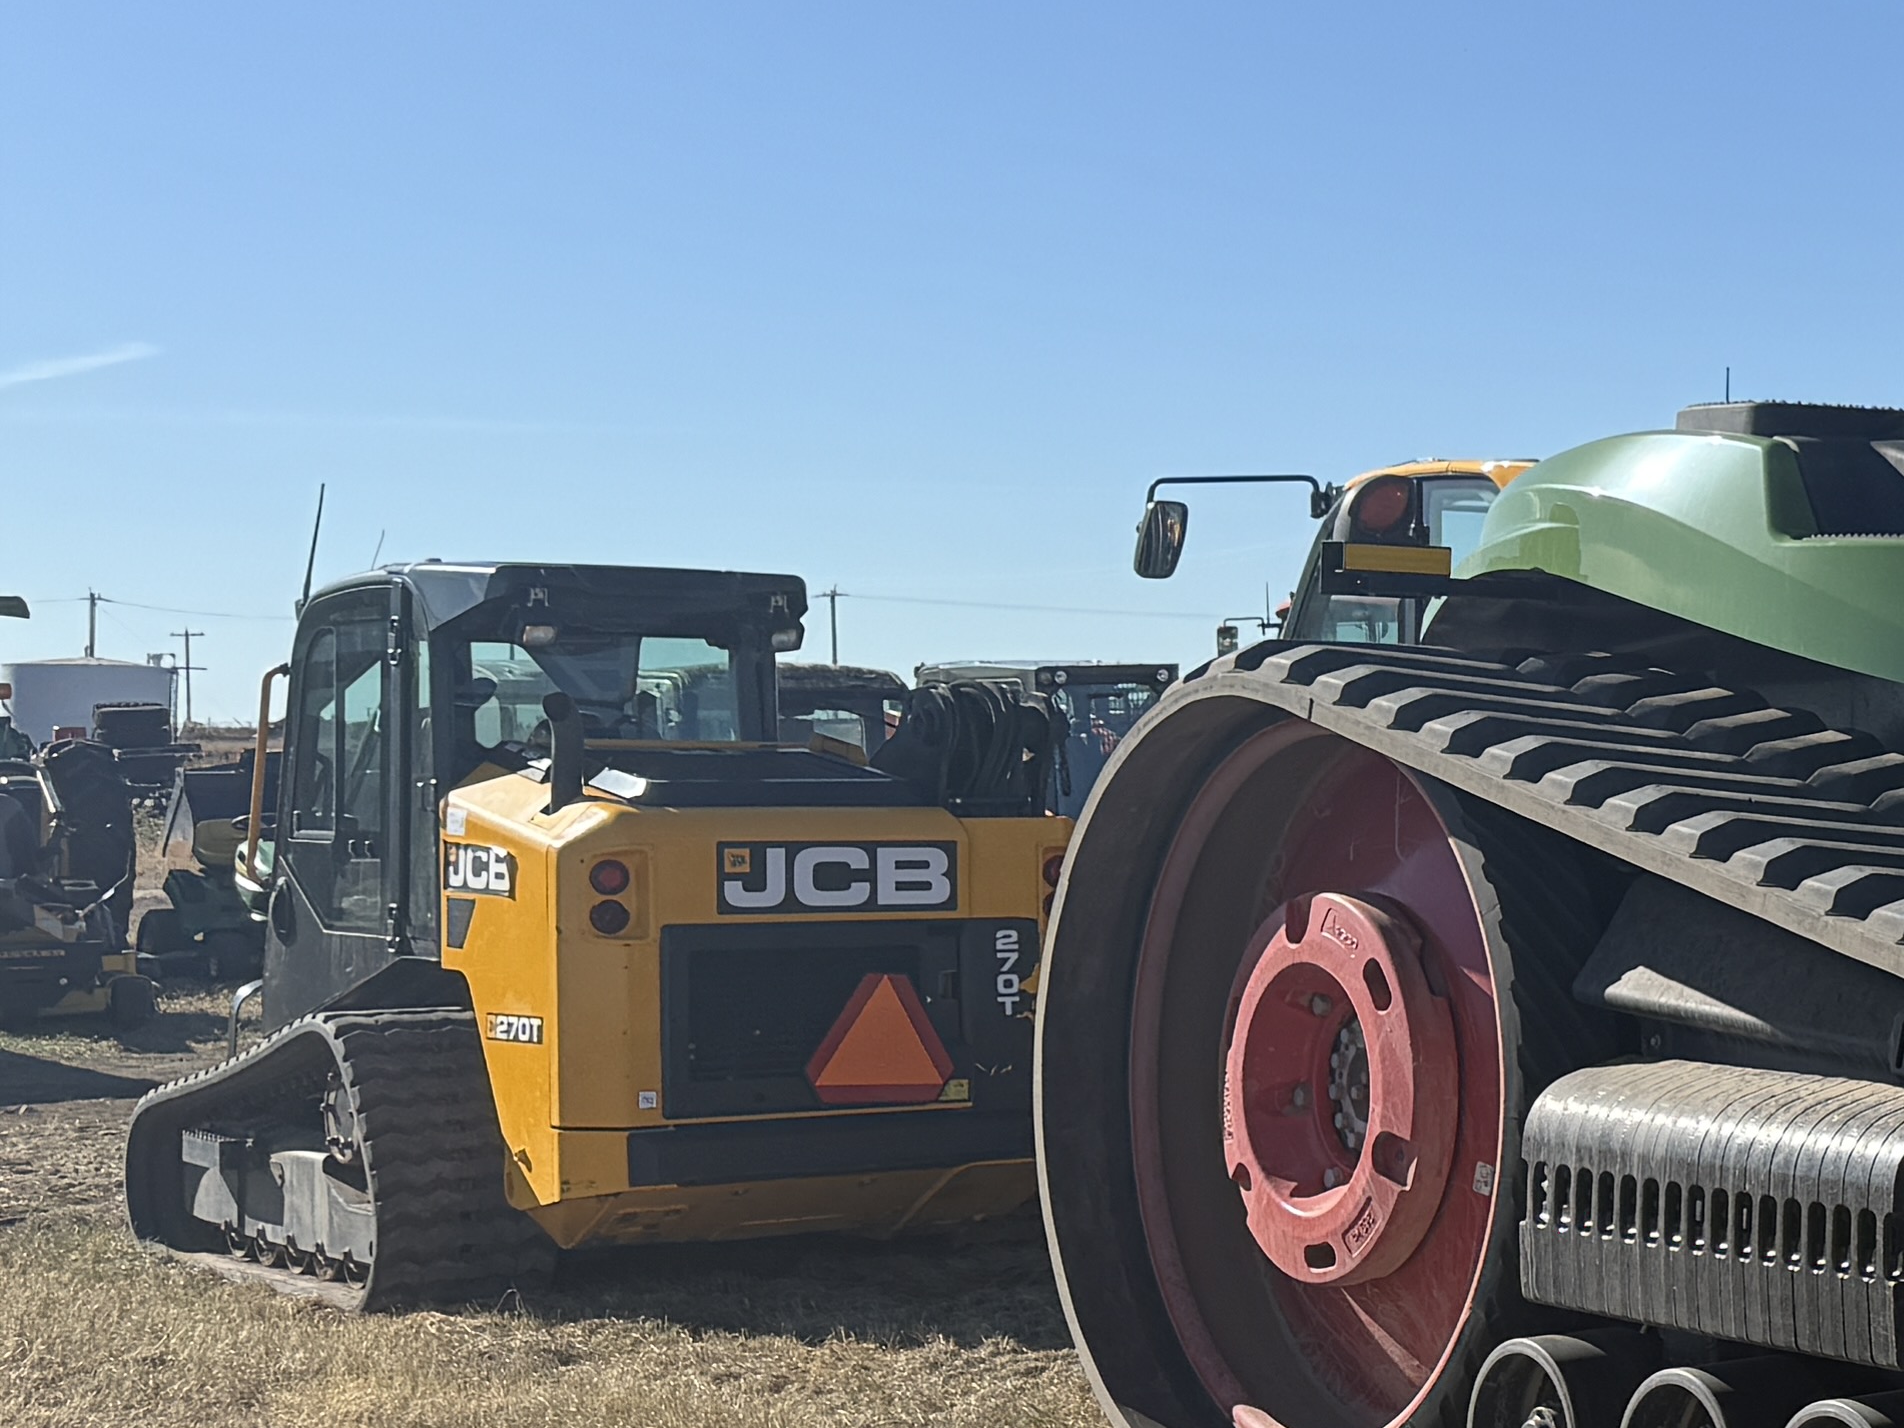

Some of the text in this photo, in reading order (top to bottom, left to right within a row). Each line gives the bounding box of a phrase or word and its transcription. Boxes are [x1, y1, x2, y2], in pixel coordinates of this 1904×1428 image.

[448, 847, 511, 891] JCB
[724, 846, 951, 908] JCB
[995, 929, 1021, 1017] 270T
[495, 1014, 543, 1043] 270T
